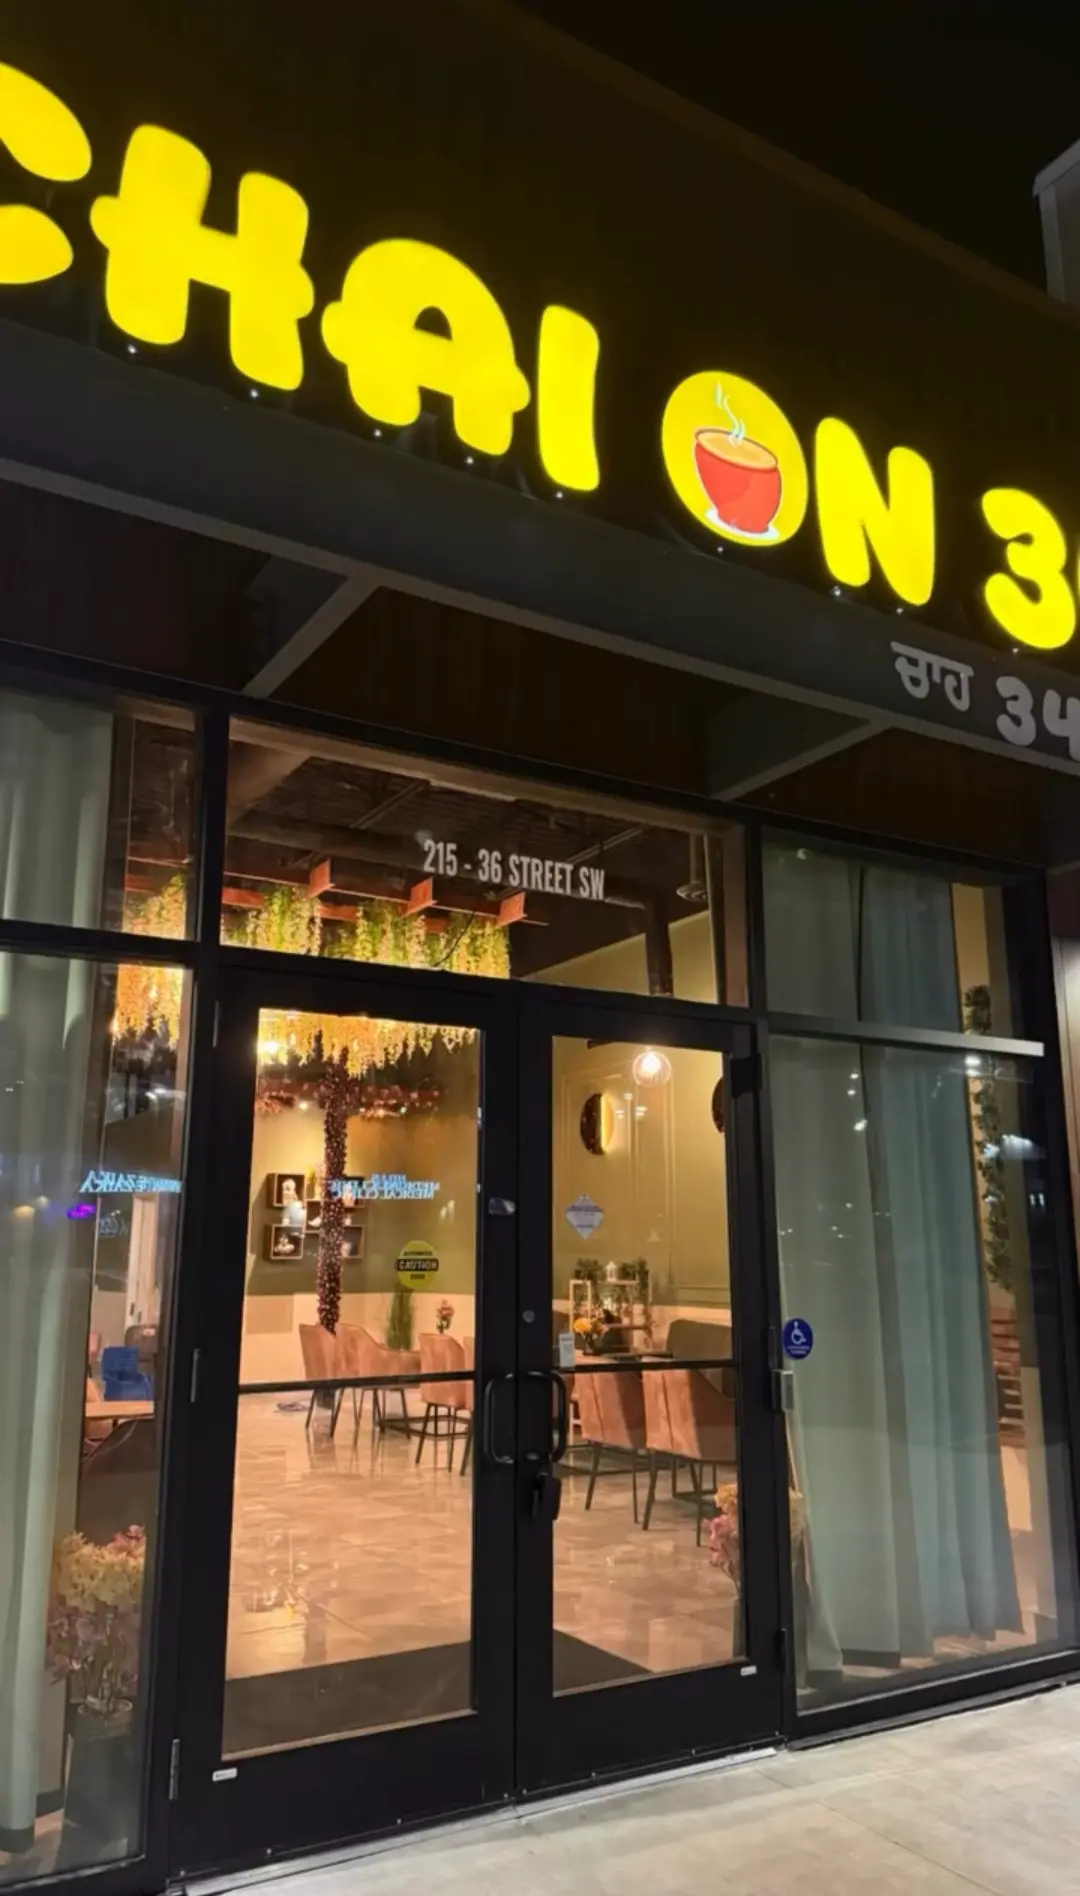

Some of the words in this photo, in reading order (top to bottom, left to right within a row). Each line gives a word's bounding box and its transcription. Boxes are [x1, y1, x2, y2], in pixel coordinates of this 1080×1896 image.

[661, 370, 936, 606] ON
[982, 488, 1080, 650] 3
[423, 839, 458, 877] 215
[478, 848, 502, 884] 36
[508, 853, 574, 896] STREET
[579, 865, 605, 900] SW
[398, 1259, 438, 1271] CAUTION
